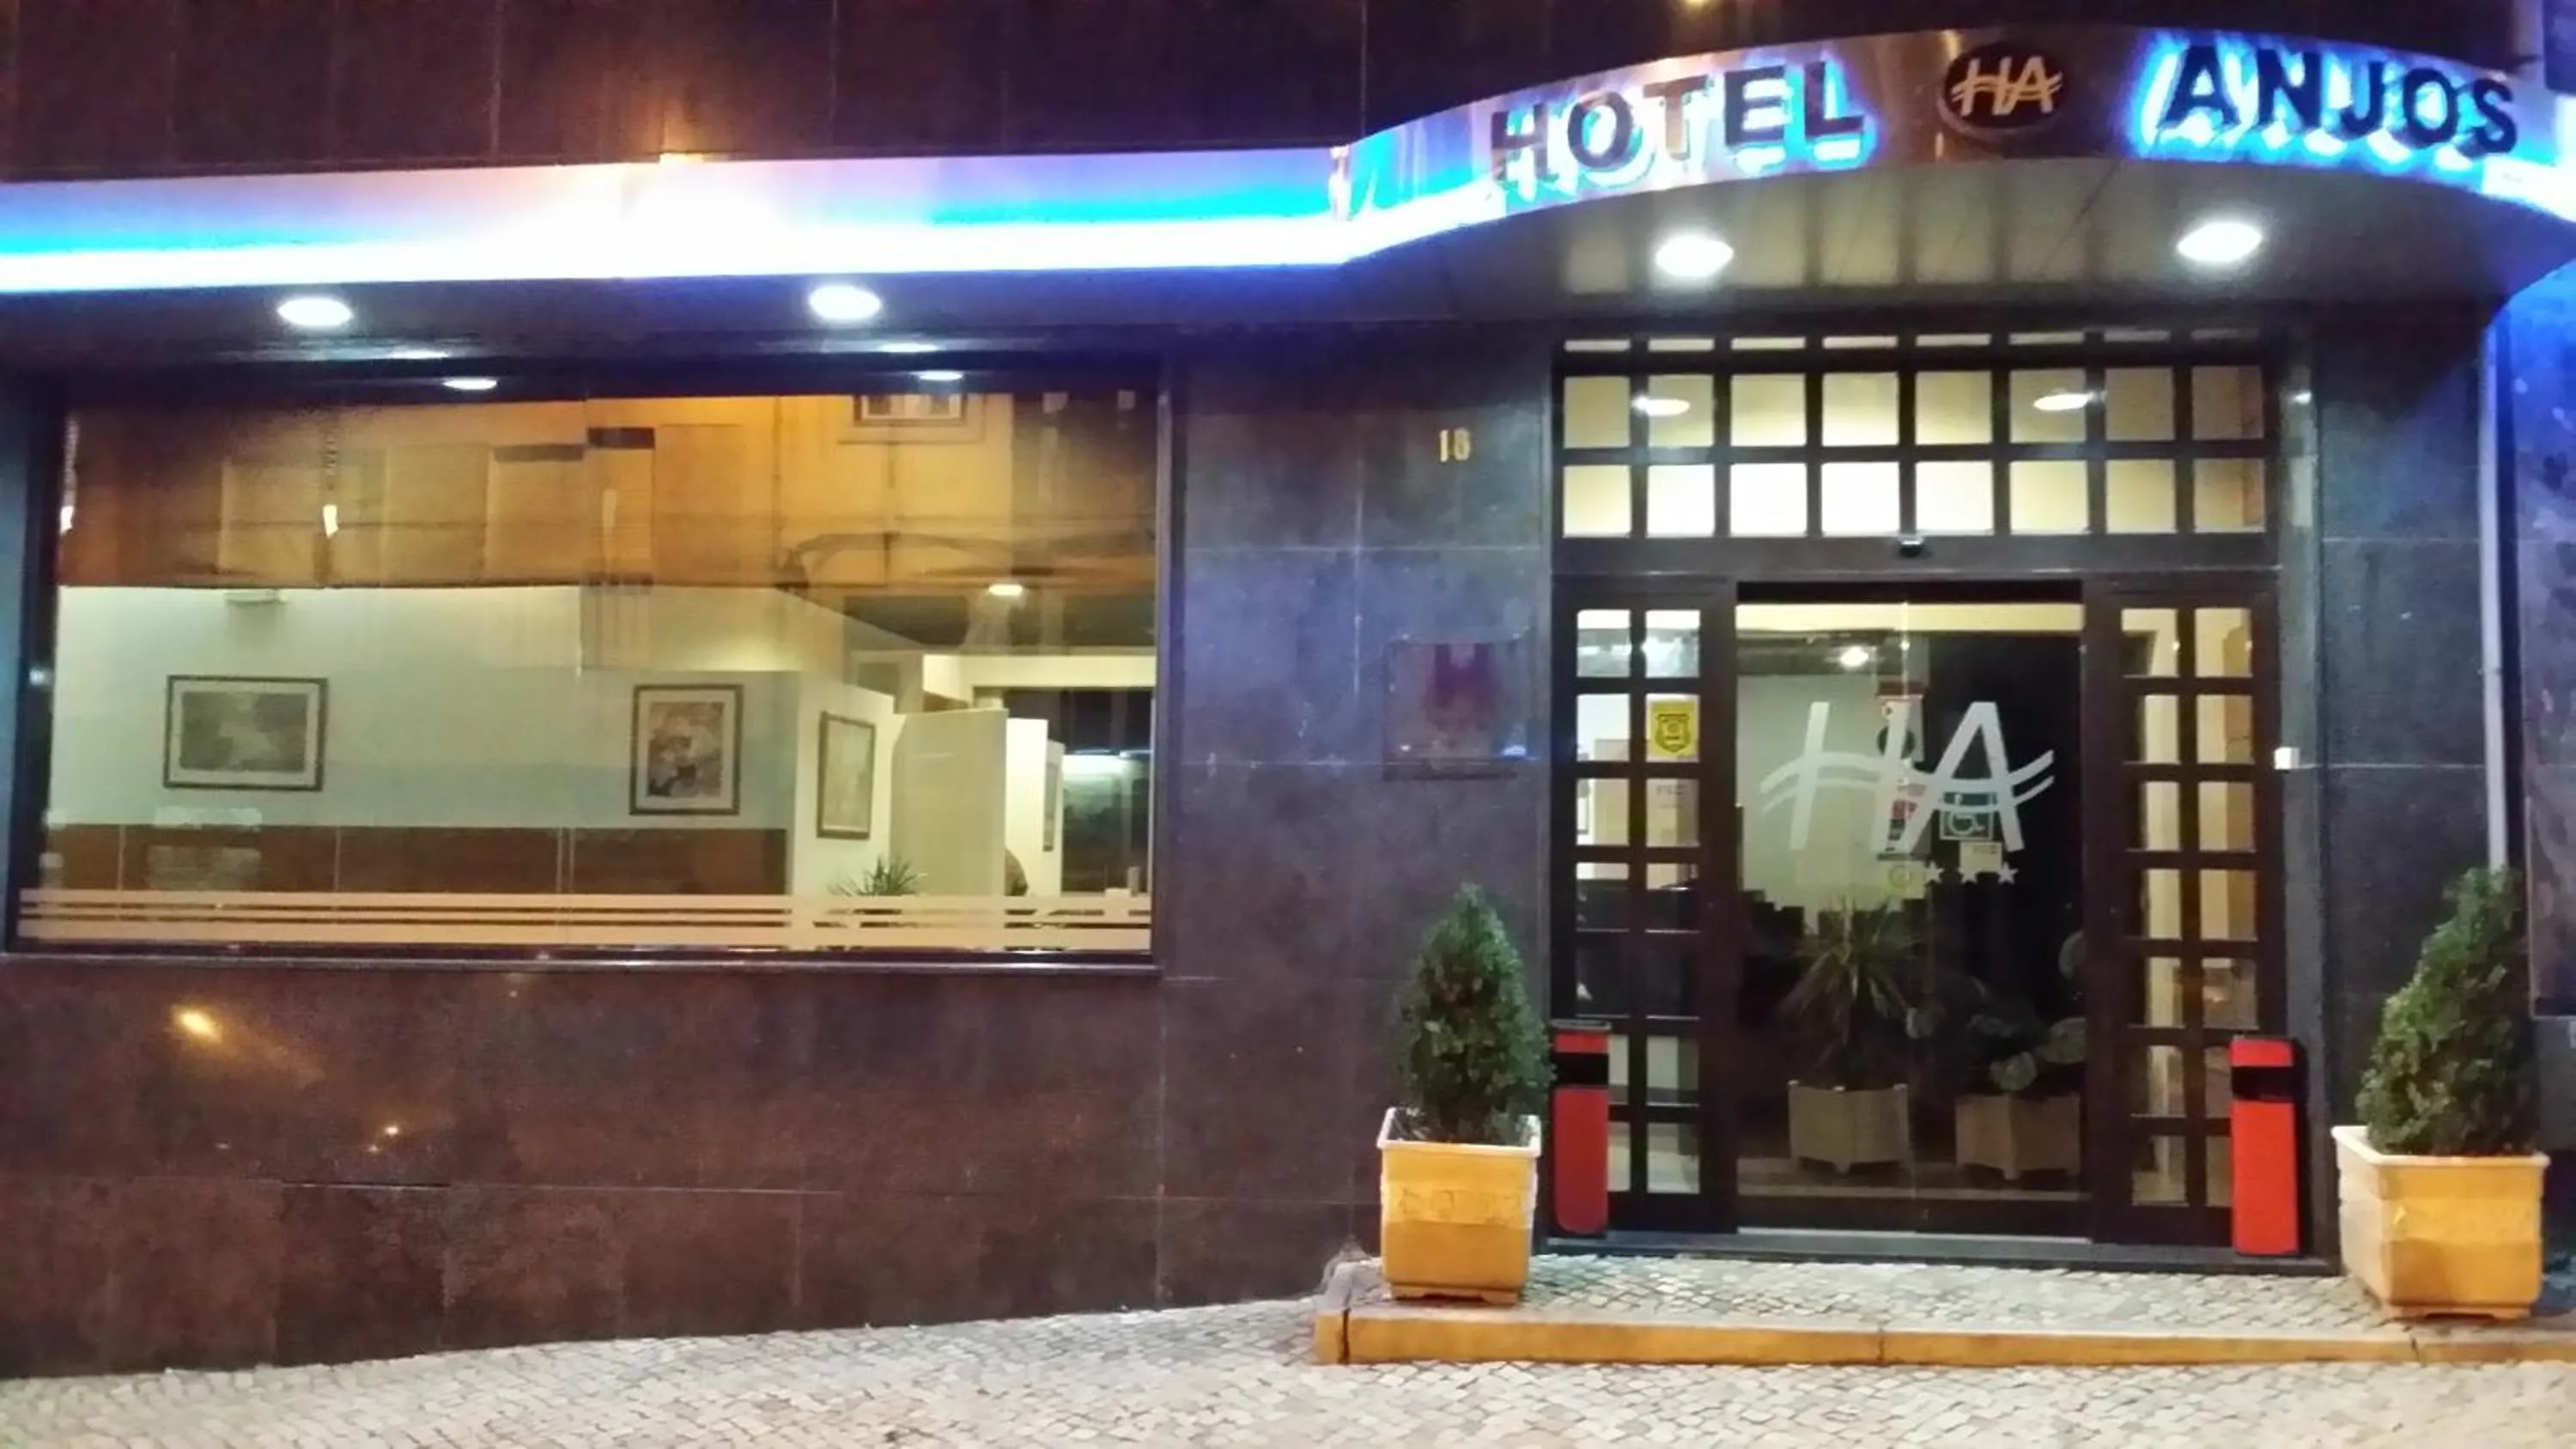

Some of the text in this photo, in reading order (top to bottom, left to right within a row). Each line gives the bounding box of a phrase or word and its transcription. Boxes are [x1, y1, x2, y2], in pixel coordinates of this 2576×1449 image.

[1490, 60, 1864, 182] HOTEL
[1951, 55, 2063, 116] HA
[2160, 45, 2517, 158] ANJOS
[1760, 700, 2055, 852] HA
